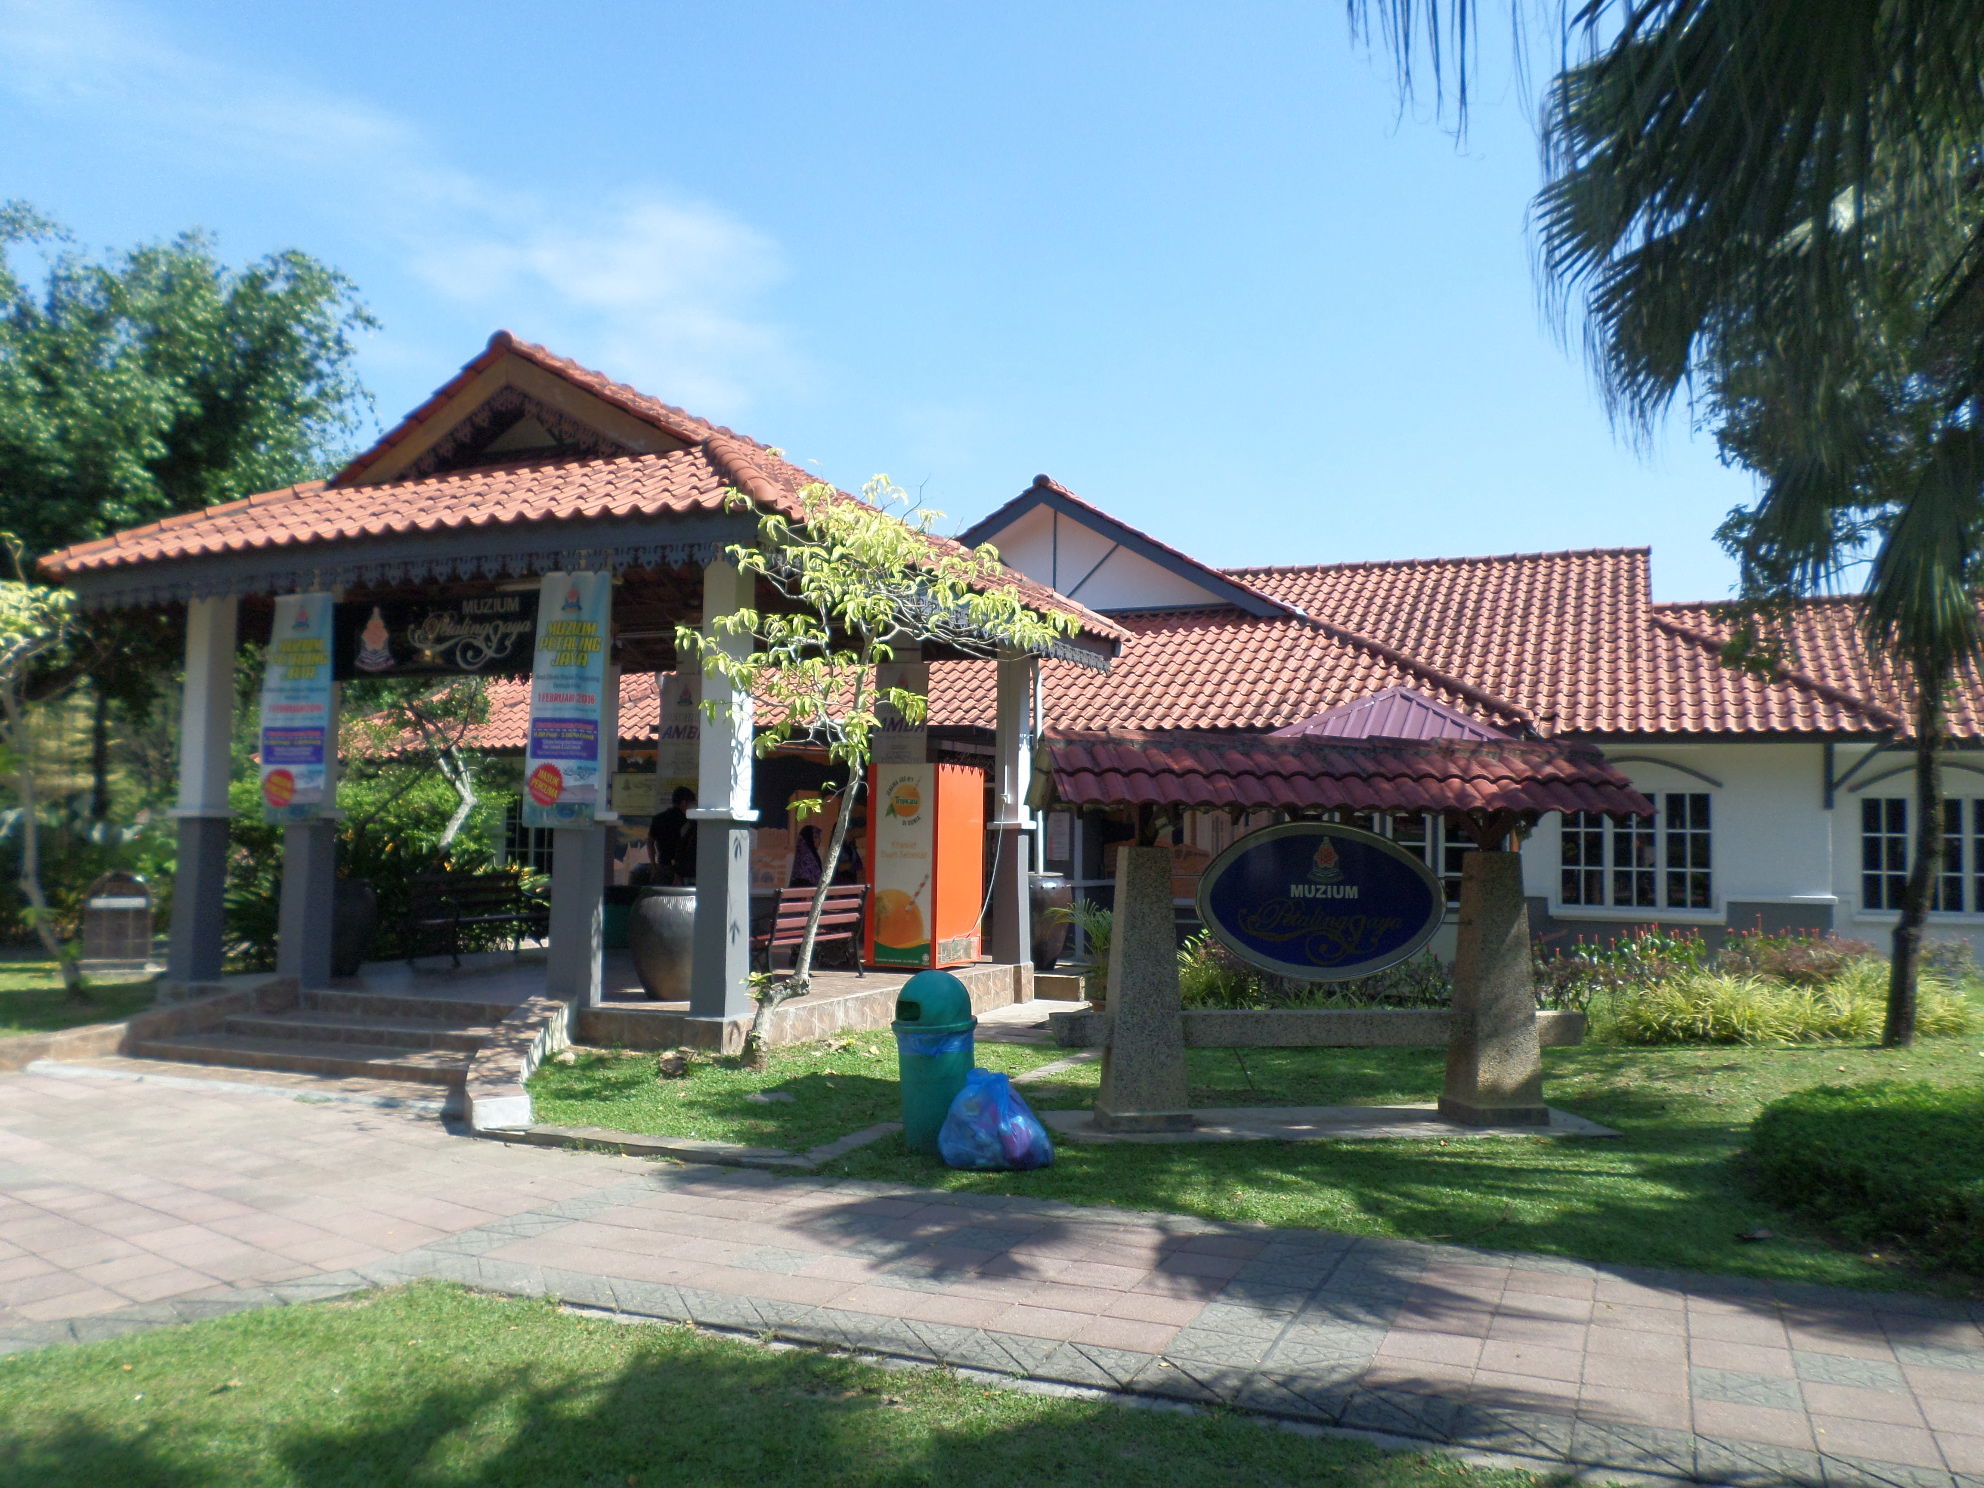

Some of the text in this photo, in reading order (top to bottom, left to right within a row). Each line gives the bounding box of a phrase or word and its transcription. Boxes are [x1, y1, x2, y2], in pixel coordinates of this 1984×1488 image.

[462, 597, 520, 615] MUZIUM
[546, 621, 597, 636] MUZIUM
[538, 636, 602, 652] PETALING
[551, 652, 588, 667] JAYA
[661, 725, 700, 740] AMB
[1290, 884, 1359, 899] MUZIUM
